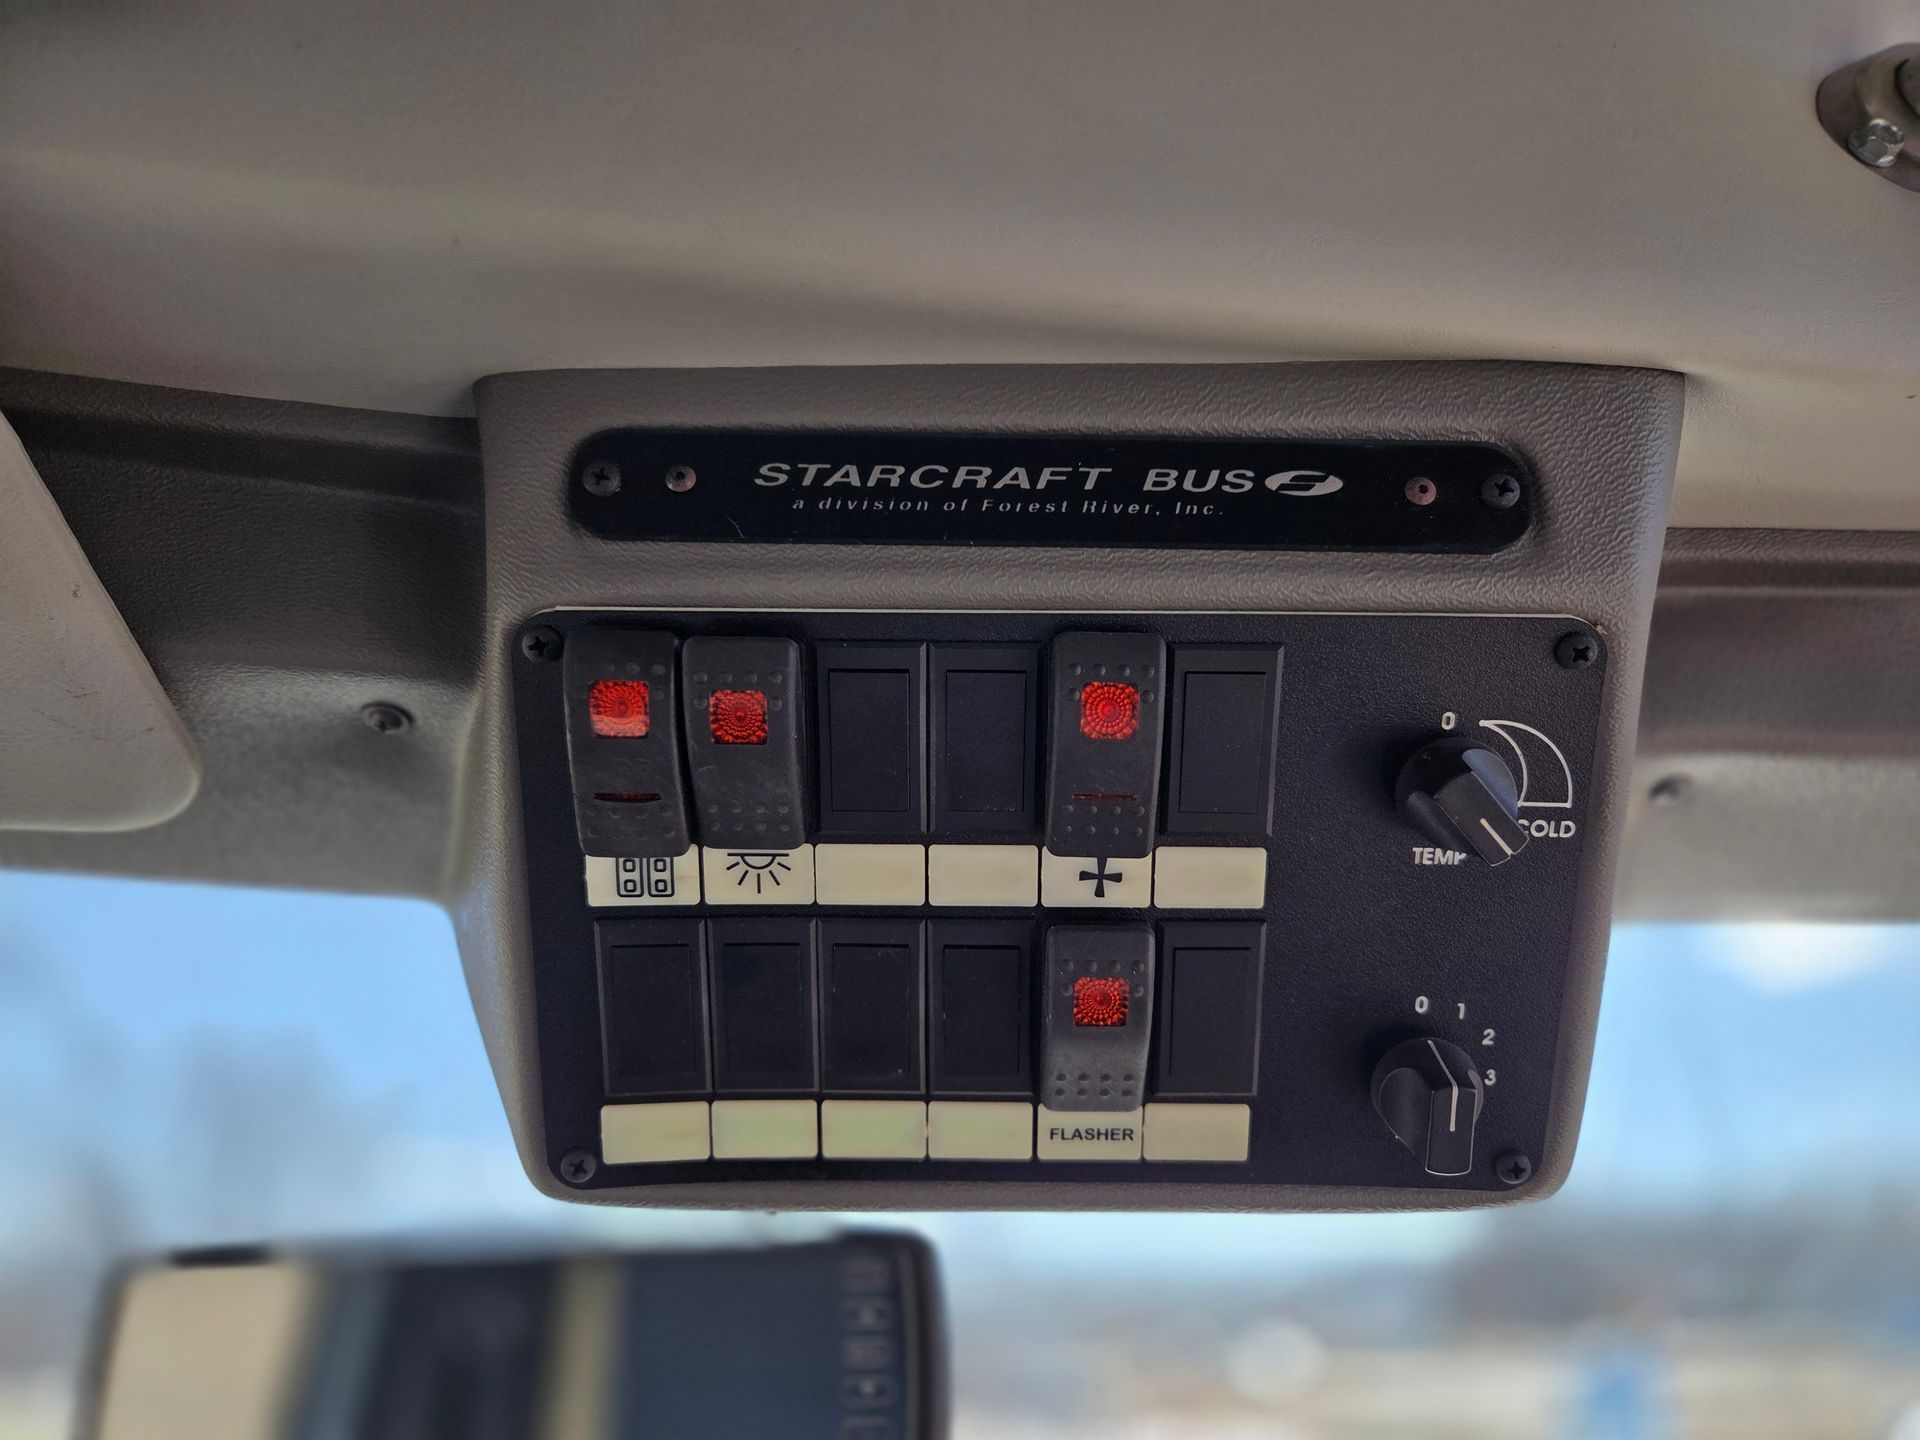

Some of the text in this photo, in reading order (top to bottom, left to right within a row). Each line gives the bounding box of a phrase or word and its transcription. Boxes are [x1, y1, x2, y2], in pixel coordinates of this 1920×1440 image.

[754, 462, 1255, 493] STARCRAFT BUS
[792, 496, 1224, 516] a division of Forest River, Inc.
[1441, 711, 1456, 731] 0
[1414, 995, 1429, 1014] 0
[1457, 1002, 1466, 1020] 1
[1481, 1028, 1496, 1046] 2
[1484, 1068, 1497, 1086] 3
[1049, 1127, 1135, 1141] FLASHER
